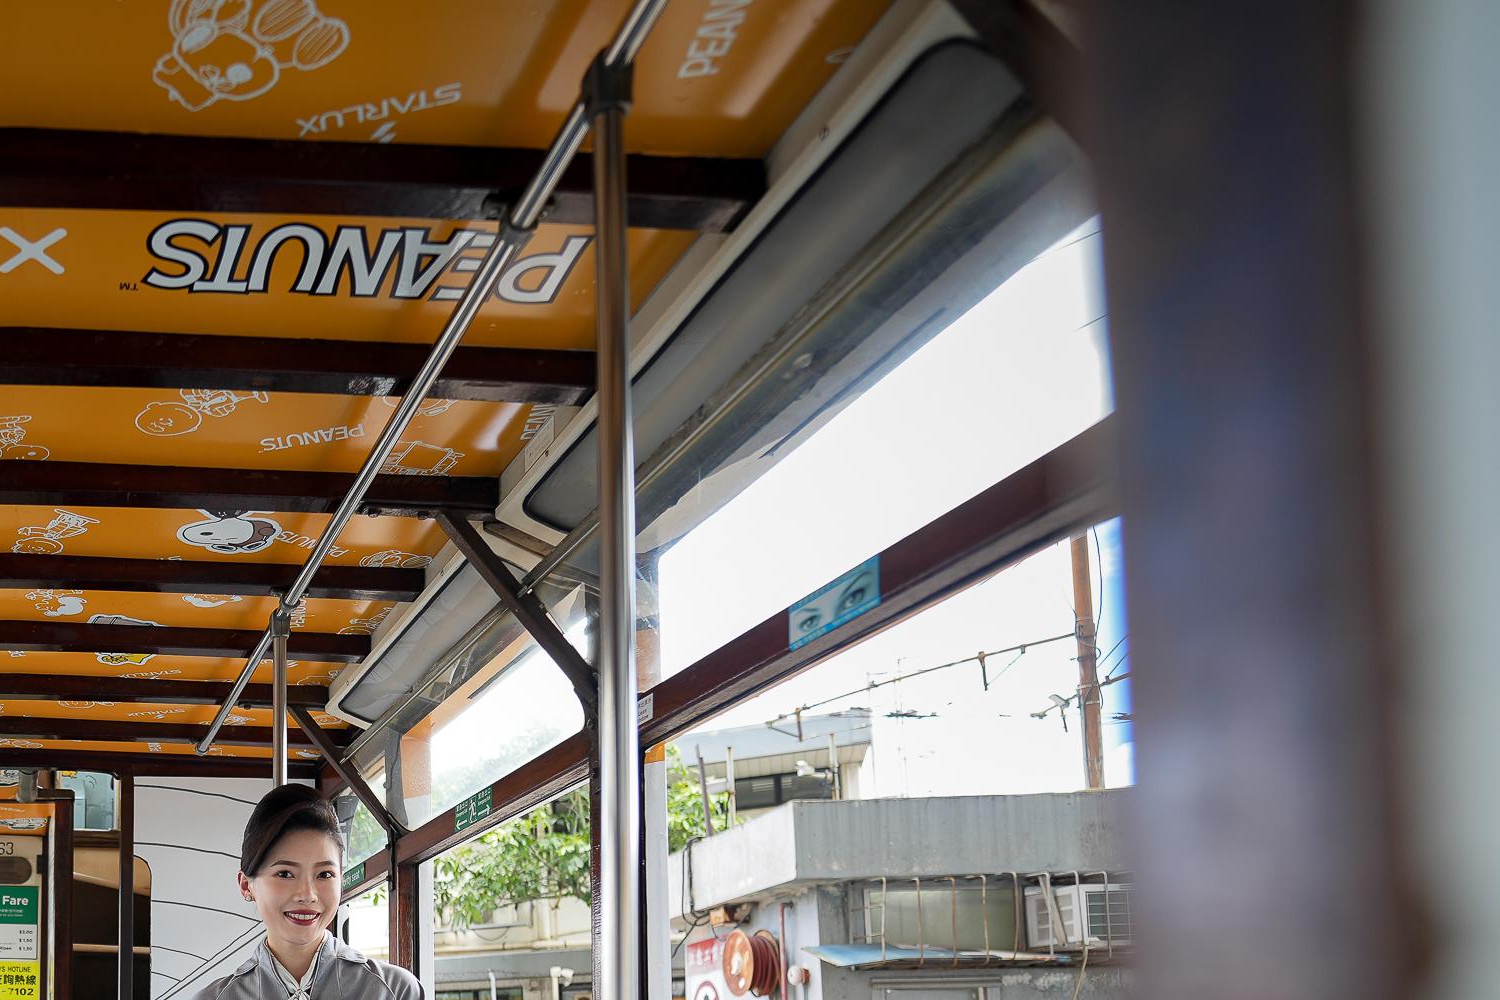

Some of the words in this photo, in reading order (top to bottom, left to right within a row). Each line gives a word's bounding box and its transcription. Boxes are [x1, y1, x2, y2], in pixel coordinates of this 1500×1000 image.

[295, 81, 463, 137] STARLUX
[140, 218, 594, 304] PEANUTS
[259, 423, 366, 452] PEANUTS
[2, 895, 29, 906] Fare
